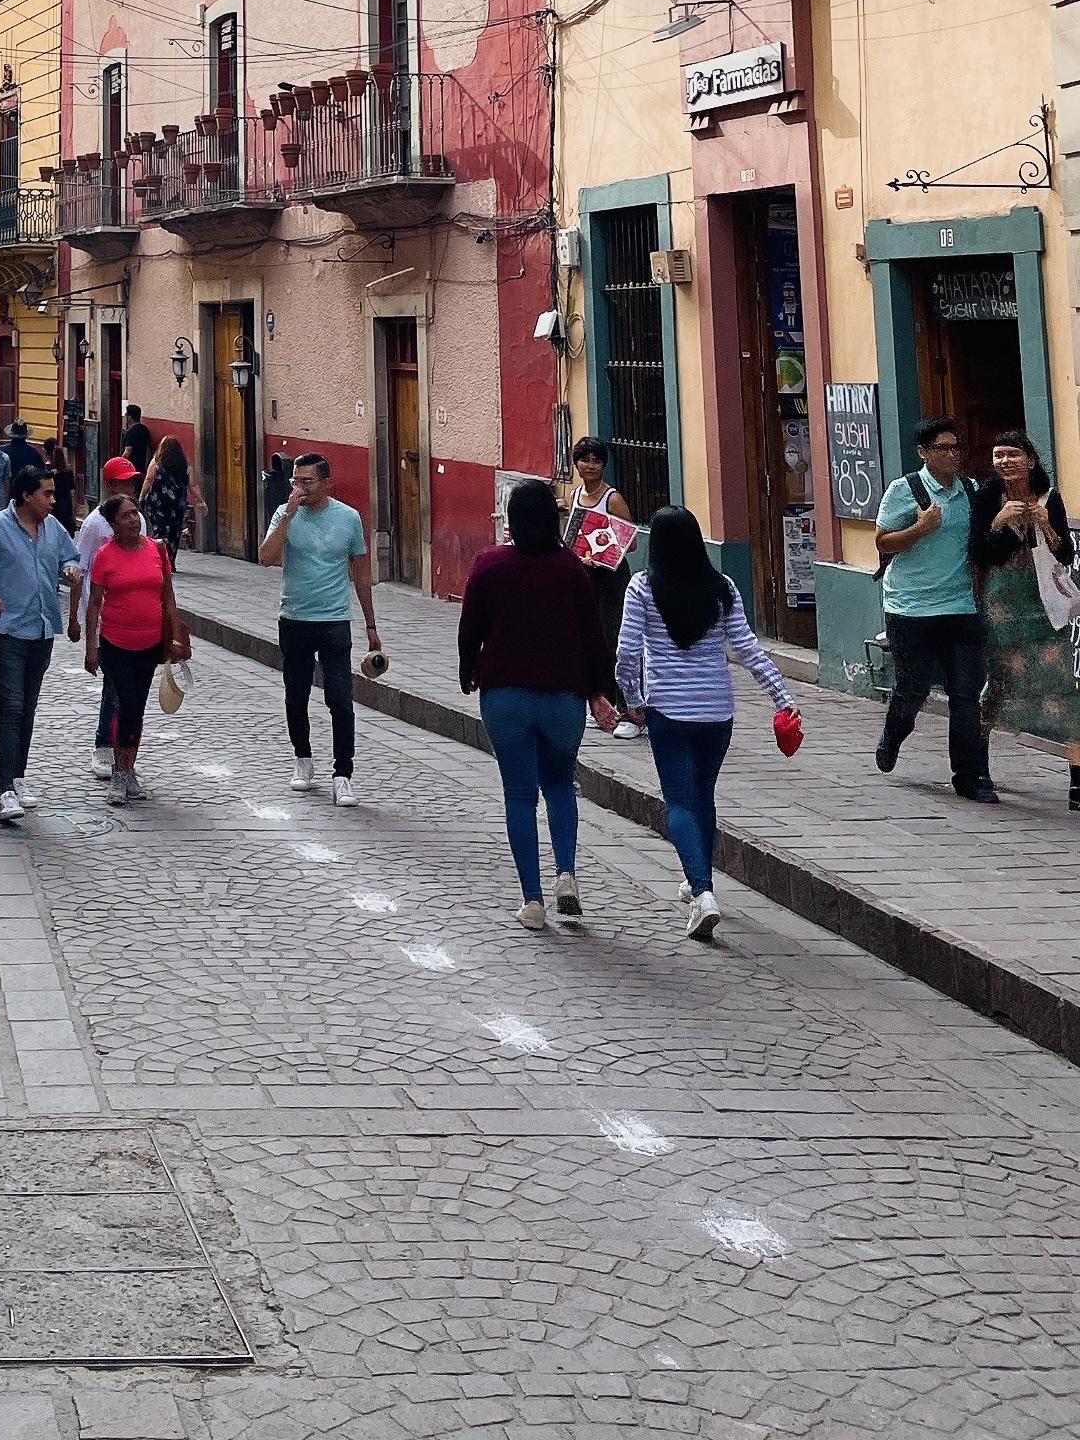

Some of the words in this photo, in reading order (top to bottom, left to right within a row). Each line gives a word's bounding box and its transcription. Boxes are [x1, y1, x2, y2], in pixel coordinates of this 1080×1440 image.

[712, 57, 780, 95] Farmacias
[942, 271, 1005, 300] HATARY
[940, 299, 979, 319] SUSHI
[991, 300, 1018, 318] RAME
[826, 383, 874, 415] HATARY
[834, 422, 870, 449] SUSHI
